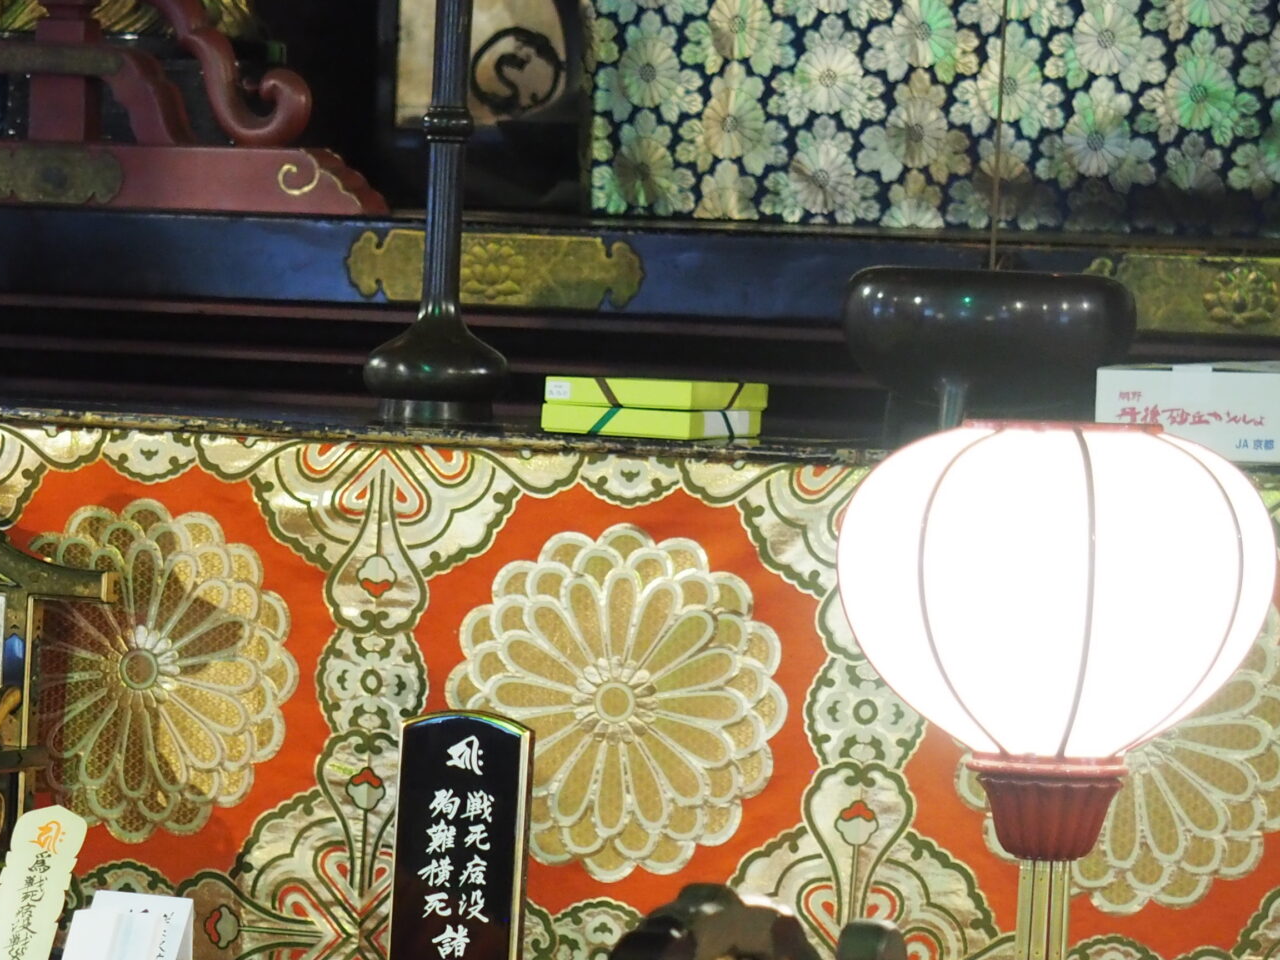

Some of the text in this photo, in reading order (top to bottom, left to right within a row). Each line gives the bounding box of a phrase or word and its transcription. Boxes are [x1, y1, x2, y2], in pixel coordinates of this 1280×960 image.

[1235, 438, 1275, 450] JA 京都
[417, 788, 461, 918] 殉難横死
